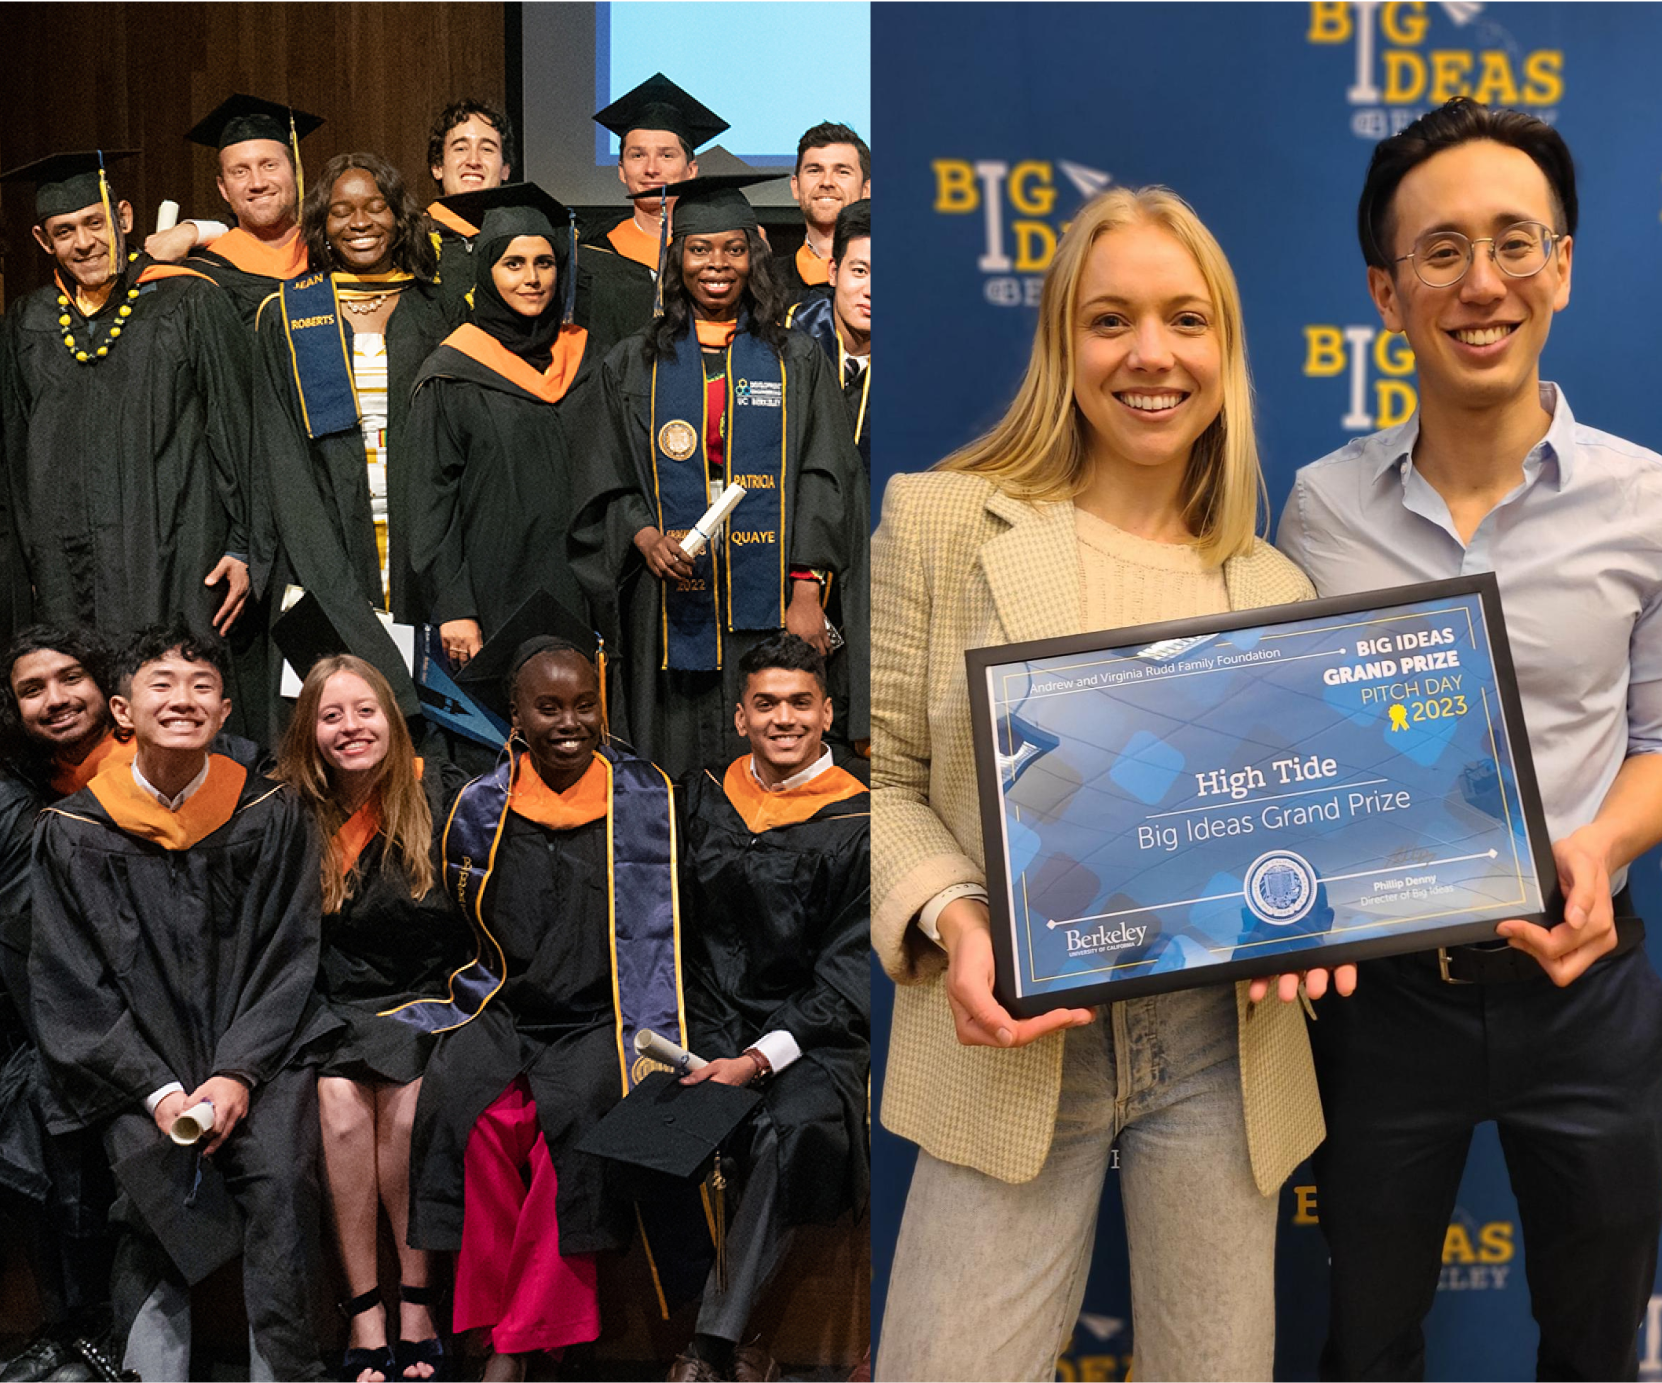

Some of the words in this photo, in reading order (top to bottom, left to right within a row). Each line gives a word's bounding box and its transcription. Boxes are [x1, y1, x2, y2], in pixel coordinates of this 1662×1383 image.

[933, 160, 1057, 216] BIG
[290, 313, 334, 331] ROBERTS
[731, 531, 775, 547] QUAYE
[1356, 637, 1393, 657] BIG
[1397, 628, 1455, 650] IDEAS
[1030, 680, 1074, 695] Andrew
[1076, 673, 1098, 687] and
[1100, 670, 1143, 684] Virginia
[1146, 664, 1176, 677] Rudd
[1178, 659, 1215, 673] Family
[1217, 649, 1281, 666] Foundation
[1323, 660, 1397, 686] GRAND
[1400, 650, 1460, 674] PRIZE
[1361, 681, 1420, 704] PITCH
[1425, 674, 1463, 695] DAY
[1411, 695, 1468, 721] 2023
[1195, 766, 1266, 799] High
[1272, 755, 1337, 784] Tide
[1138, 825, 1178, 851] Big
[1186, 814, 1254, 842] Ideas
[1261, 796, 1340, 829] Grand
[1348, 790, 1411, 816] Prize
[1373, 879, 1404, 892] Phillip
[1405, 874, 1437, 887] Denny
[1400, 891, 1411, 900] of
[1412, 888, 1428, 899] Big
[1064, 921, 1147, 951] Berkeley
[1068, 948, 1098, 957] UNIVERSITY
